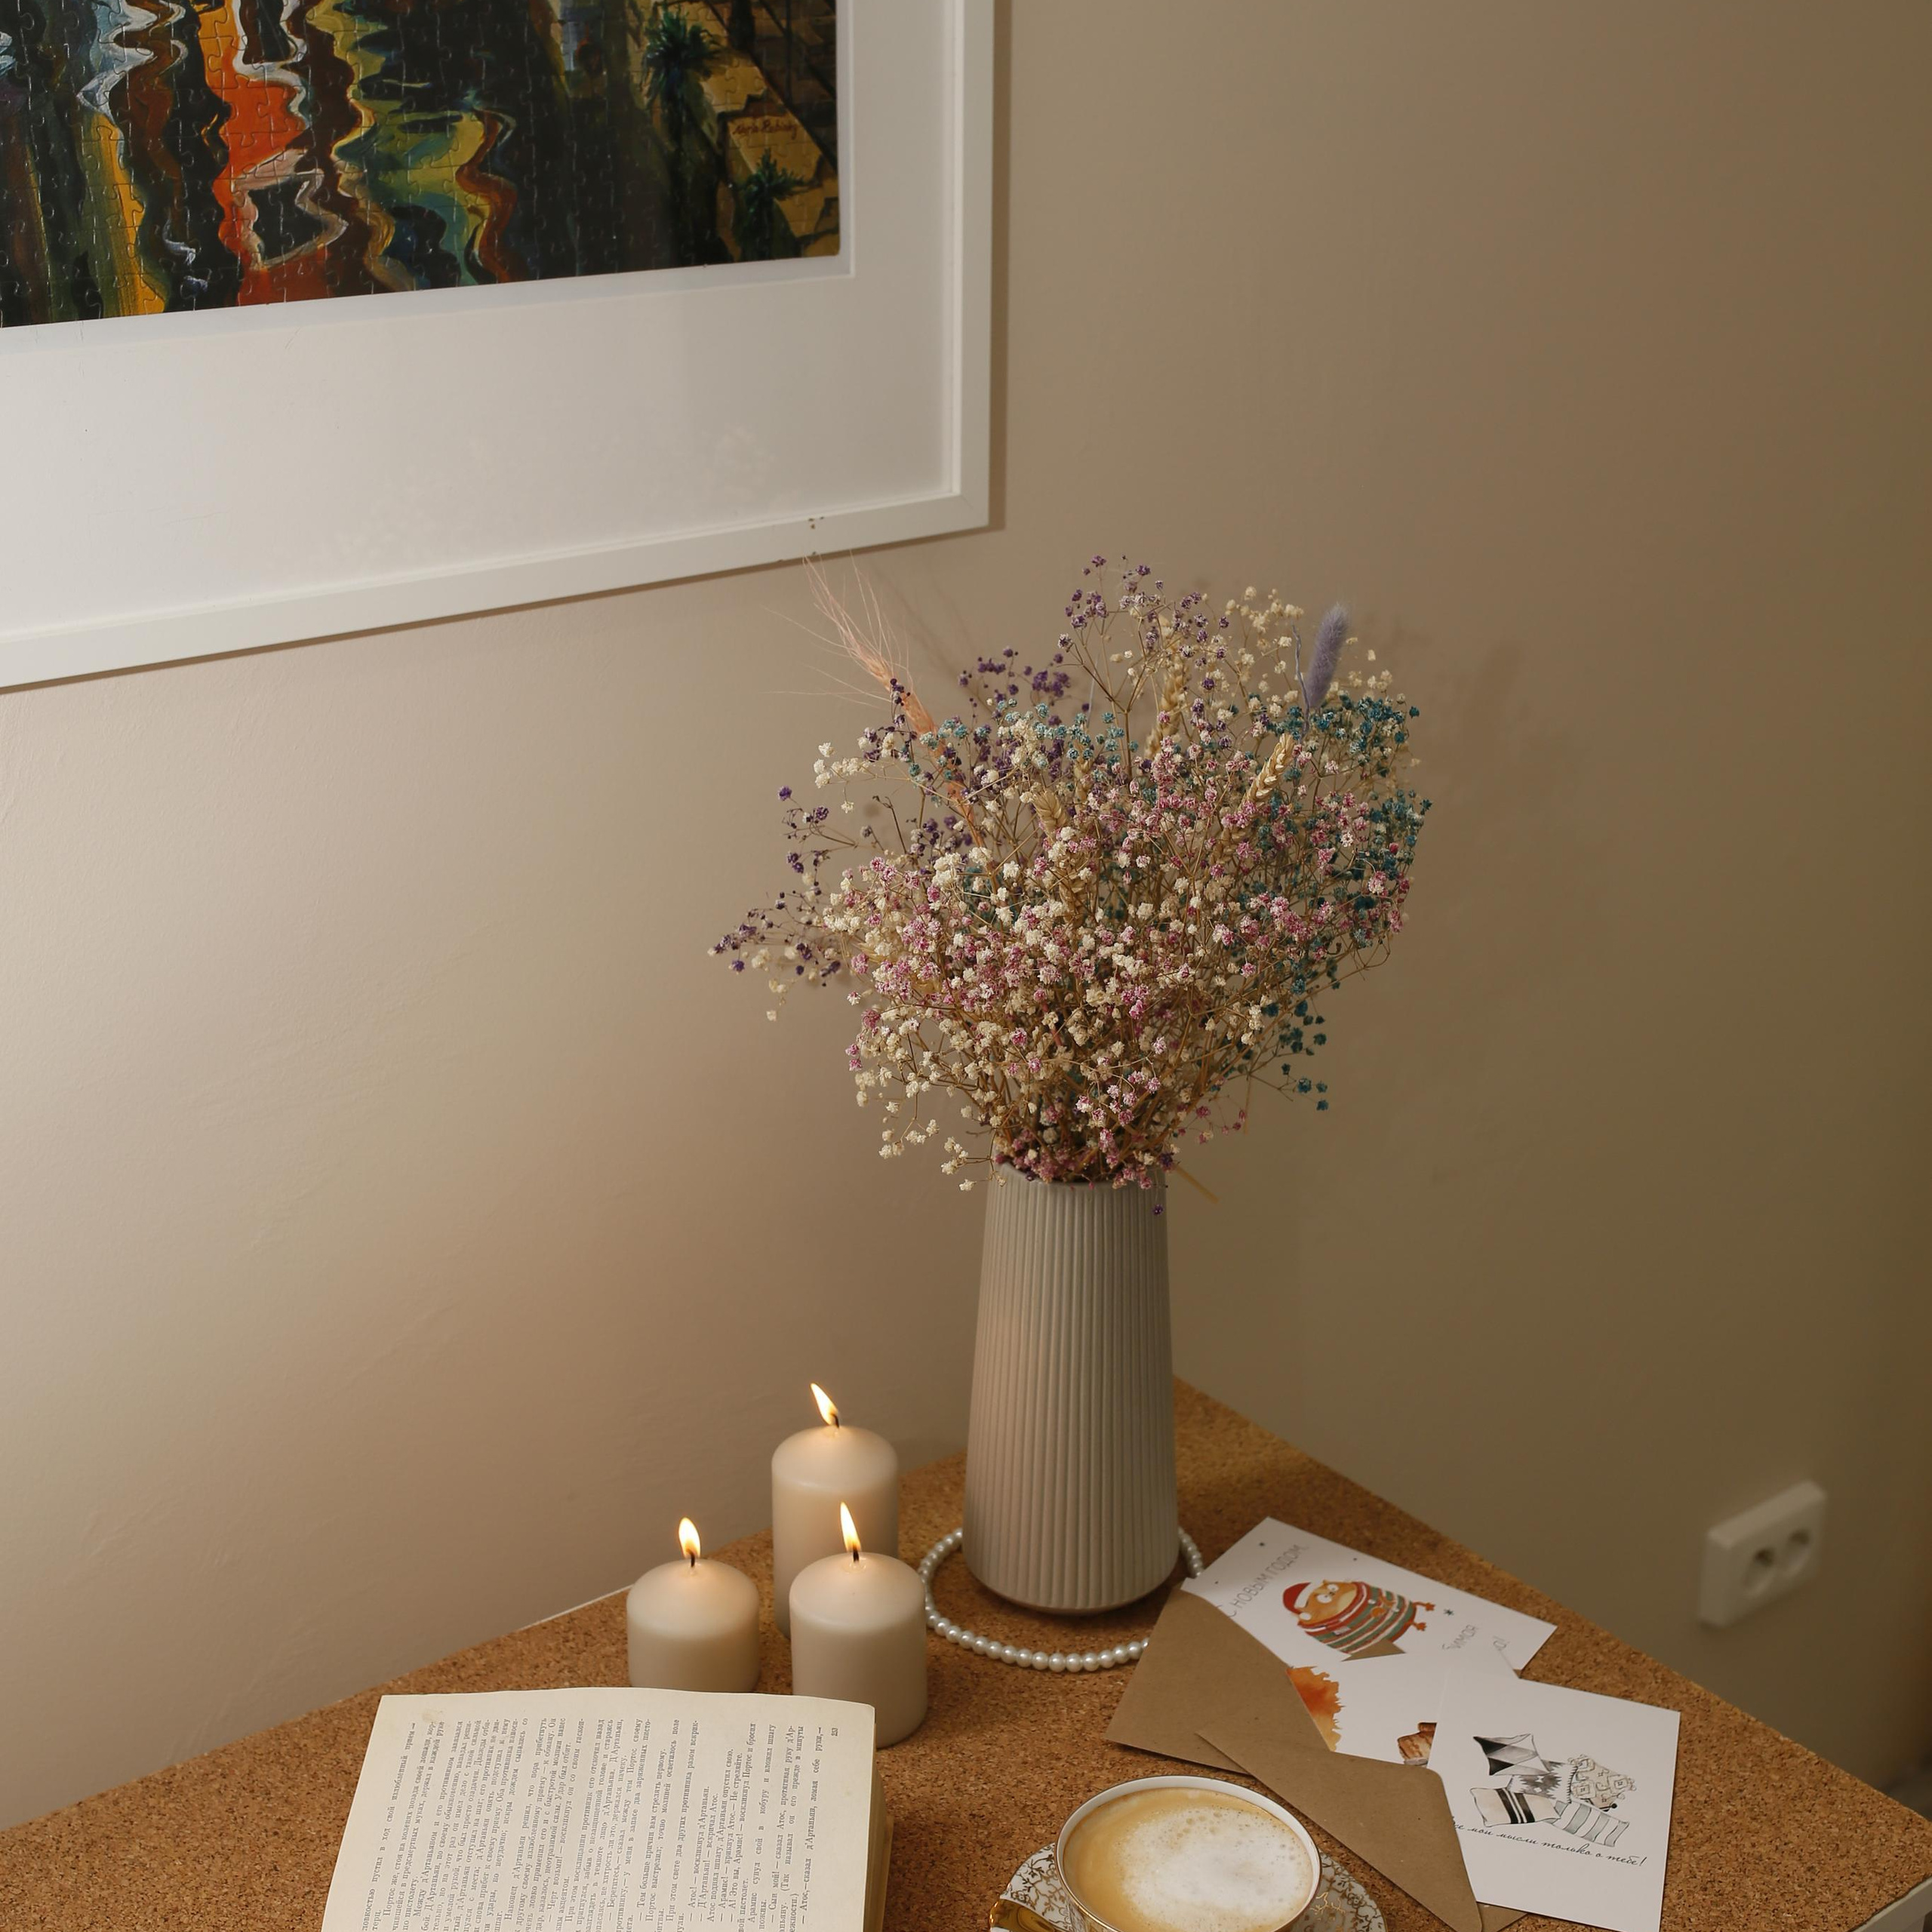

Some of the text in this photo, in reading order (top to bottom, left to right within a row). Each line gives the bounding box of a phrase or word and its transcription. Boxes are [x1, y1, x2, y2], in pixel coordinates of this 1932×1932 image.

[495, 1788, 506, 1802] Оба
[554, 1781, 567, 1800] Удар
[681, 1771, 693, 1813] противника
[758, 1789, 770, 1814] кобуру
[811, 1780, 819, 1801] ломая
[463, 1804, 473, 1829] просто
[581, 1792, 593, 1830] противник
[621, 1799, 632, 1823] между
[457, 1832, 468, 1847] был
[470, 1866, 481, 1890] места;
[485, 1791, 495, 1812] опять
[528, 1770, 558, 1909] ловко применил его быстротой
[602, 1850, 613, 1884] хитрость
[611, 1786, 623, 1822] держался
[617, 1829, 626, 1854] сказал
[624, 1846, 633, 1865] меня
[629, 1809, 638, 1833] запасе
[677, 1816, 687, 1841] других
[706, 1814, 716, 1848] вскричал
[728, 1780, 750, 1897] Это Арамис! воскликнул
[382, 1887, 396, 1916] Портос
[394, 1854, 404, 1870] стоя
[401, 1811, 413, 1840] коленях
[408, 1786, 420, 1810] позади
[432, 1780, 468, 1931] тельно, этот раз имел дело
[456, 1849, 464, 1863] что
[466, 1829, 478, 1863] отступил
[486, 1836, 498, 1862] своему
[486, 1890, 498, 1916] удары,
[495, 1830, 509, 1867] неудачно;
[503, 1801, 513, 1824] искры
[515, 1776, 548, 1926] другому своему излюбленному приему
[544, 1826, 558, 1874] неотразимой
[546, 1801, 573, 1909] Черт возьми! воскликнул
[574, 1834, 586, 1882] восклицании
[576, 1883, 590, 1925] пригнулся,
[583, 1857, 592, 1880] забыв
[589, 1789, 603, 1844] незащищенной
[593, 1846, 604, 1876] темноте
[599, 1822, 608, 1840] лицо
[636, 1781, 662, 1908] Тем больше причин вам стрелять
[645, 1783, 672, 1921] Портос выстрелил; точно молнией
[714, 1844, 724, 1870] шпагу,
[775, 1834, 783, 1860] сказал
[784, 1833, 794, 1865] называл
[1497, 1833, 1539, 1845] мысли
[1541, 1841, 1592, 1856] только
[1604, 1856, 1647, 1866] тебе!
[361, 1806, 395, 1931] ловкостью пустил ход свой
[392, 1890, 405, 1931] чившейся
[402, 1827, 420, 1879] предсмертных
[420, 1914, 431, 1931] бой.
[438, 1823, 451, 1848] своему
[450, 1865, 462, 1890] рукой,
[672, 1860, 681, 1880] свете
[687, 1887, 697, 1909] Атос!
[693, 1831, 705, 1874] воскликнул
[718, 1832, 735, 1909] Арамис! крикнул
[752, 1862, 762, 1884] сунул
[771, 1871, 780, 1888] мой!
[780, 1873, 791, 1891] (Так
[405, 1876, 420, 1918] пистолету.
[479, 1872, 490, 1899] прибег
[538, 1876, 552, 1912] казалось,
[558, 1876, 570, 1914] акцентом.
[570, 1885, 579, 1903] этом
[669, 1883, 678, 1901] этом
[710, 1872, 719, 1900] поднял
[739, 1878, 749, 1915] пистолет.
[412, 1888, 427, 1917] Между
[444, 1894, 455, 1922] умелой
[475, 1901, 485, 1924] снова
[503, 1886, 518, 1920] Наконец
[564, 1906, 576, 1921] При
[665, 1904, 677, 1921] При
[706, 1902, 716, 1922] Атос
[747, 1892, 758, 1923] Арамис
[758, 1899, 767, 1930] ножны.
[768, 1893, 778, 1910] Сын
[371, 1909, 382, 1931] терц.
